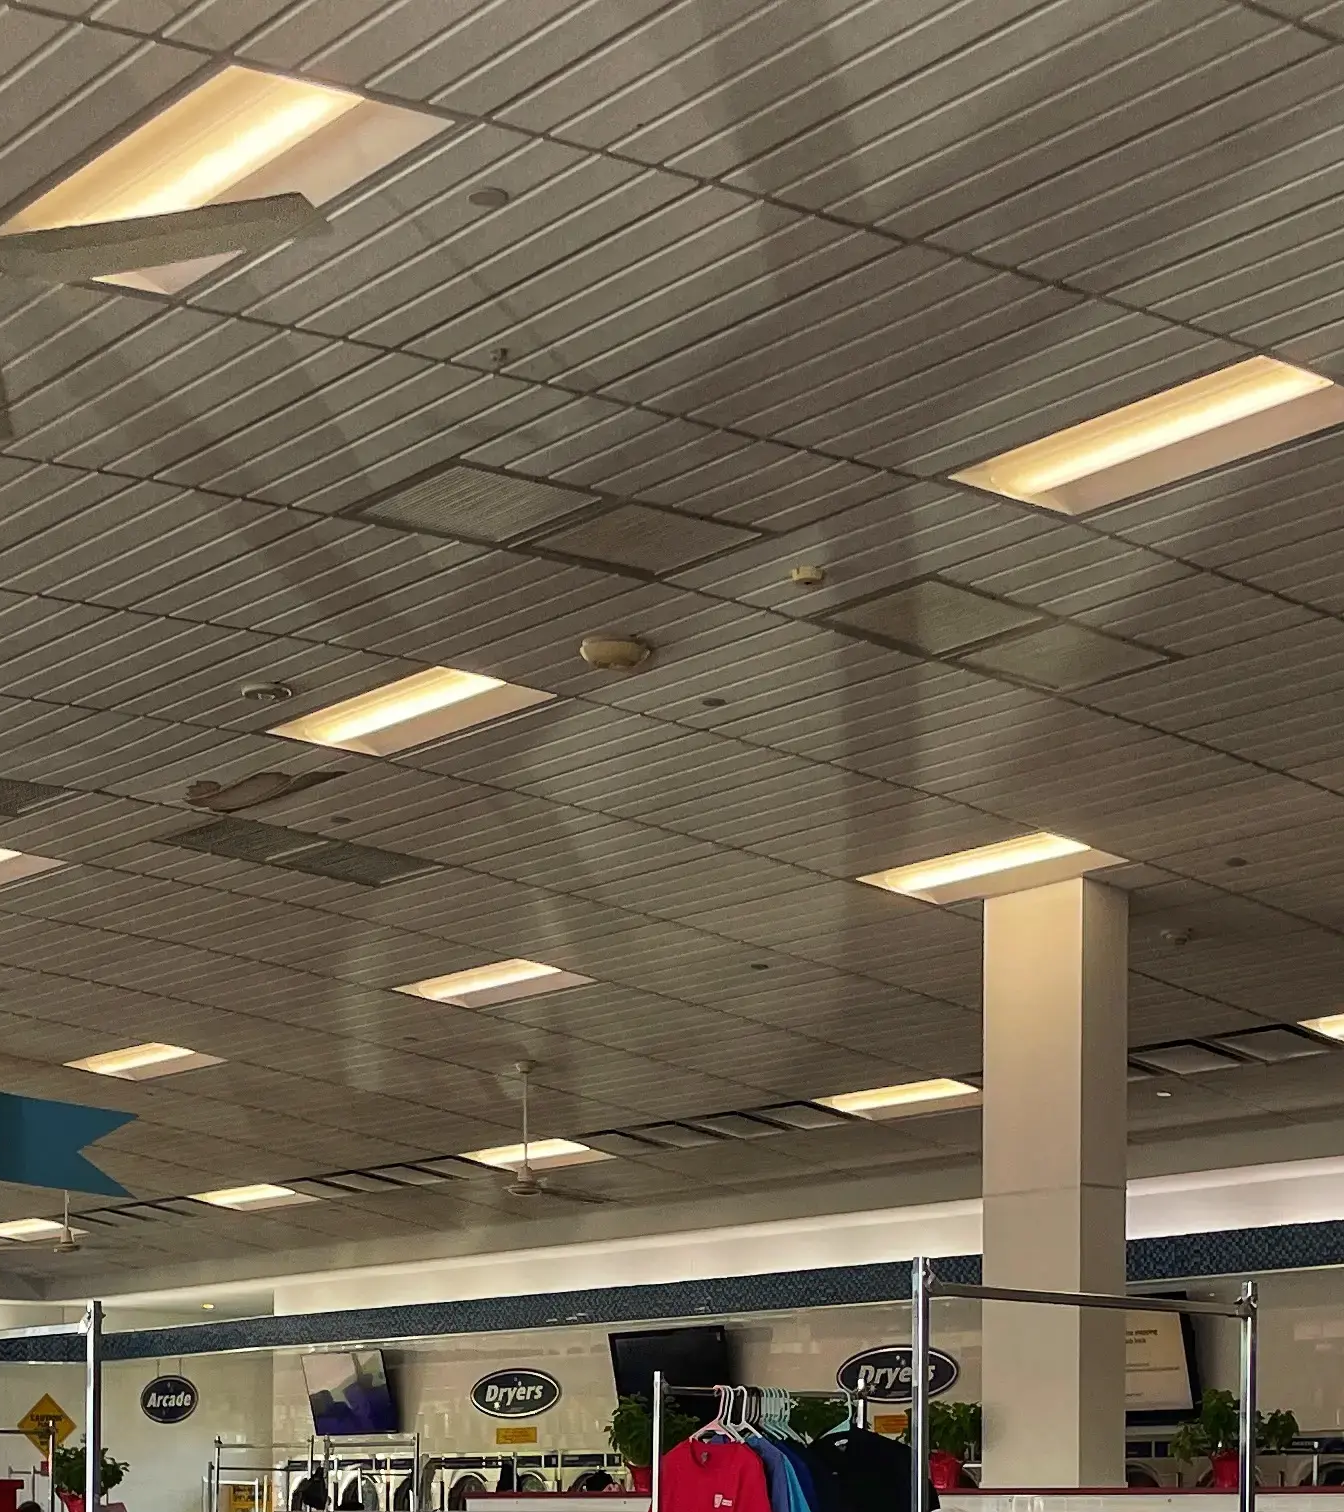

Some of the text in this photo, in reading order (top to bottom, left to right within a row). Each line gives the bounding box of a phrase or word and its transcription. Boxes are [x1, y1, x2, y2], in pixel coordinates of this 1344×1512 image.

[857, 1364, 936, 1390] Dryes
[146, 1391, 192, 1408] Arcade
[485, 1384, 544, 1406] Dryers
